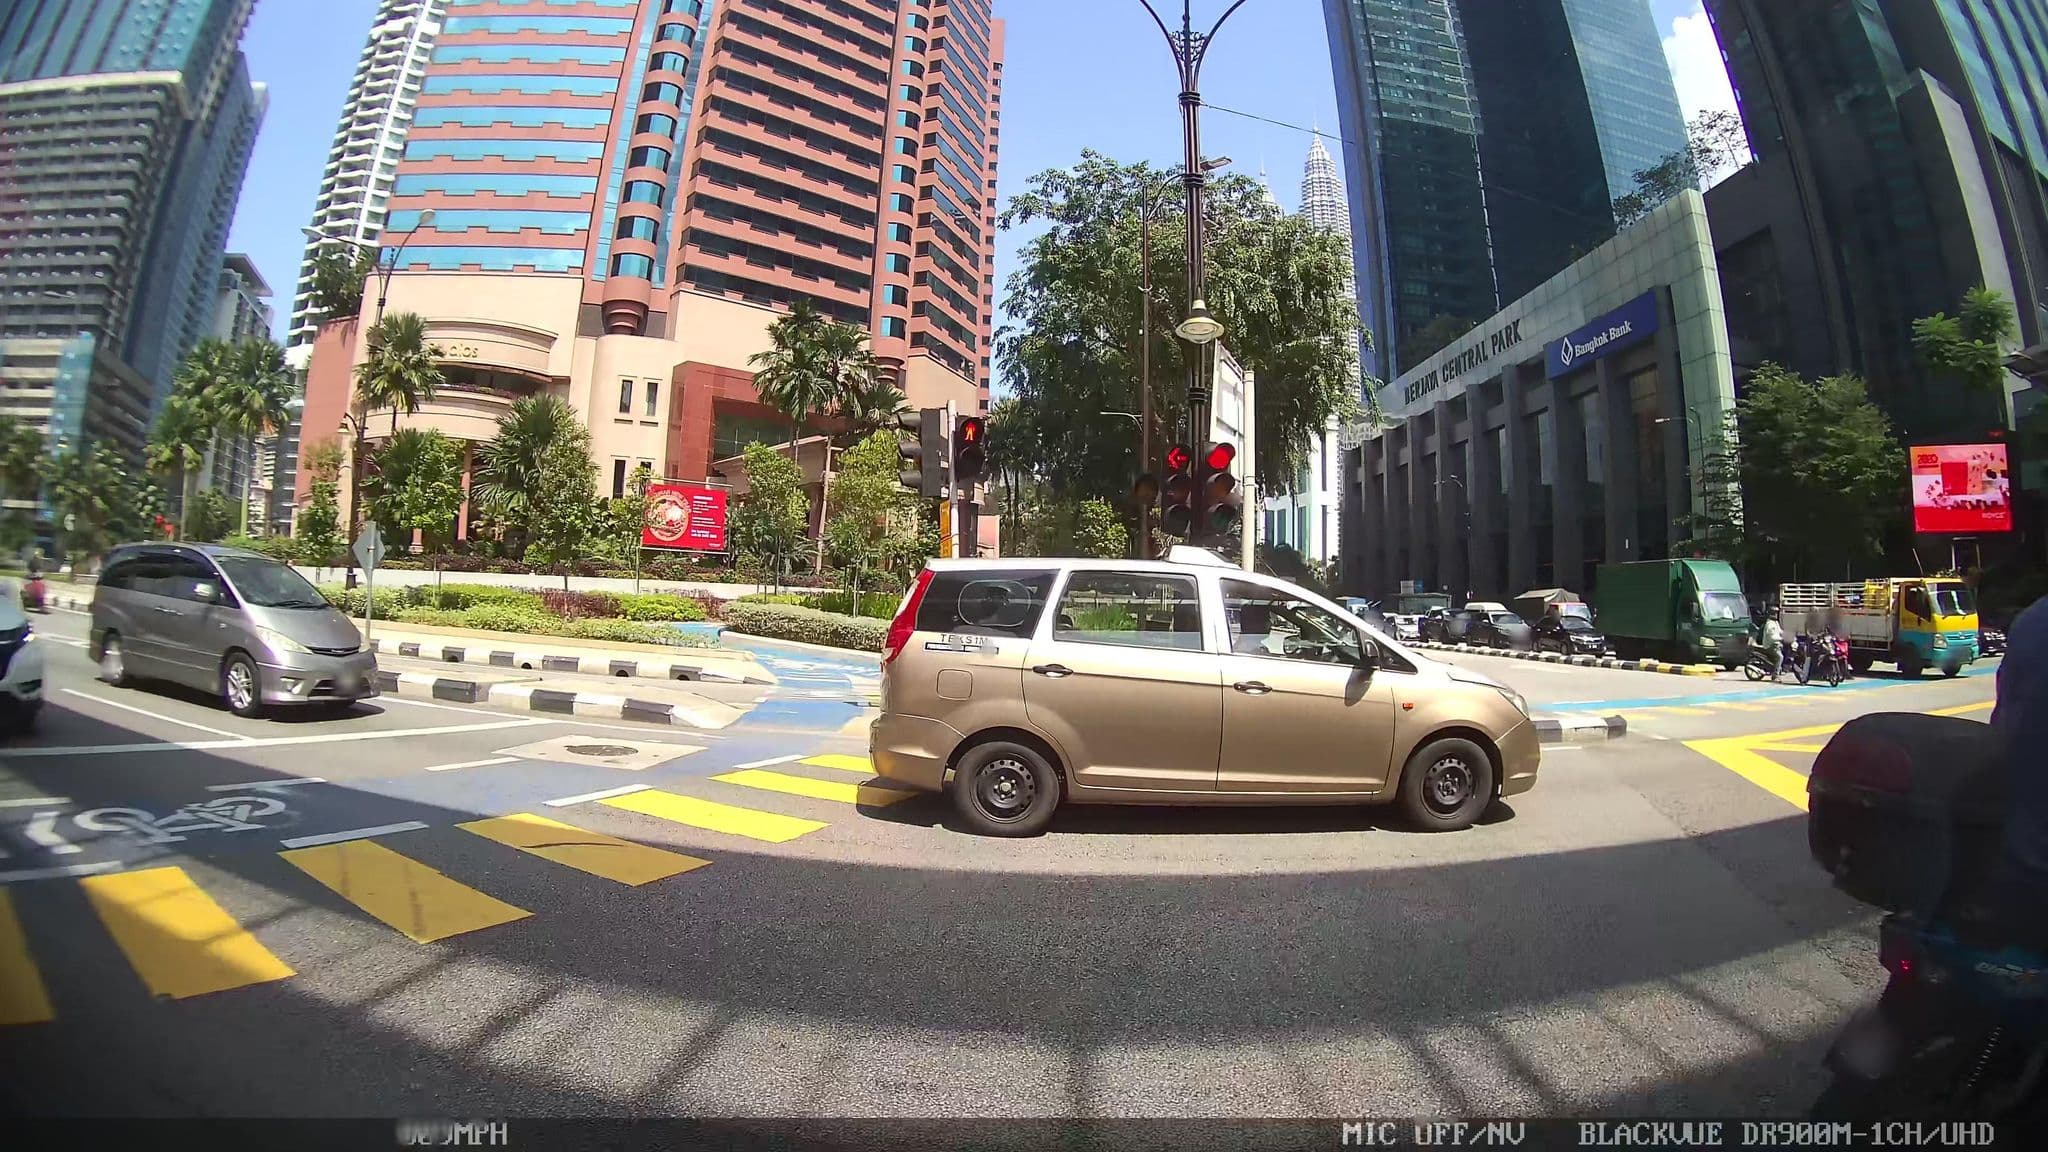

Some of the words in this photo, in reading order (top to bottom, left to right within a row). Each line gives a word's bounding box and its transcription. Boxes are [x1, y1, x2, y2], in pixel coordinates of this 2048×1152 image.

[1404, 369, 1439, 405] BERJAYA
[1442, 341, 1488, 383] CENTRAL
[1491, 319, 1522, 355] PARK
[1575, 331, 1609, 357] Bangkok
[1609, 320, 1632, 340] Bank
